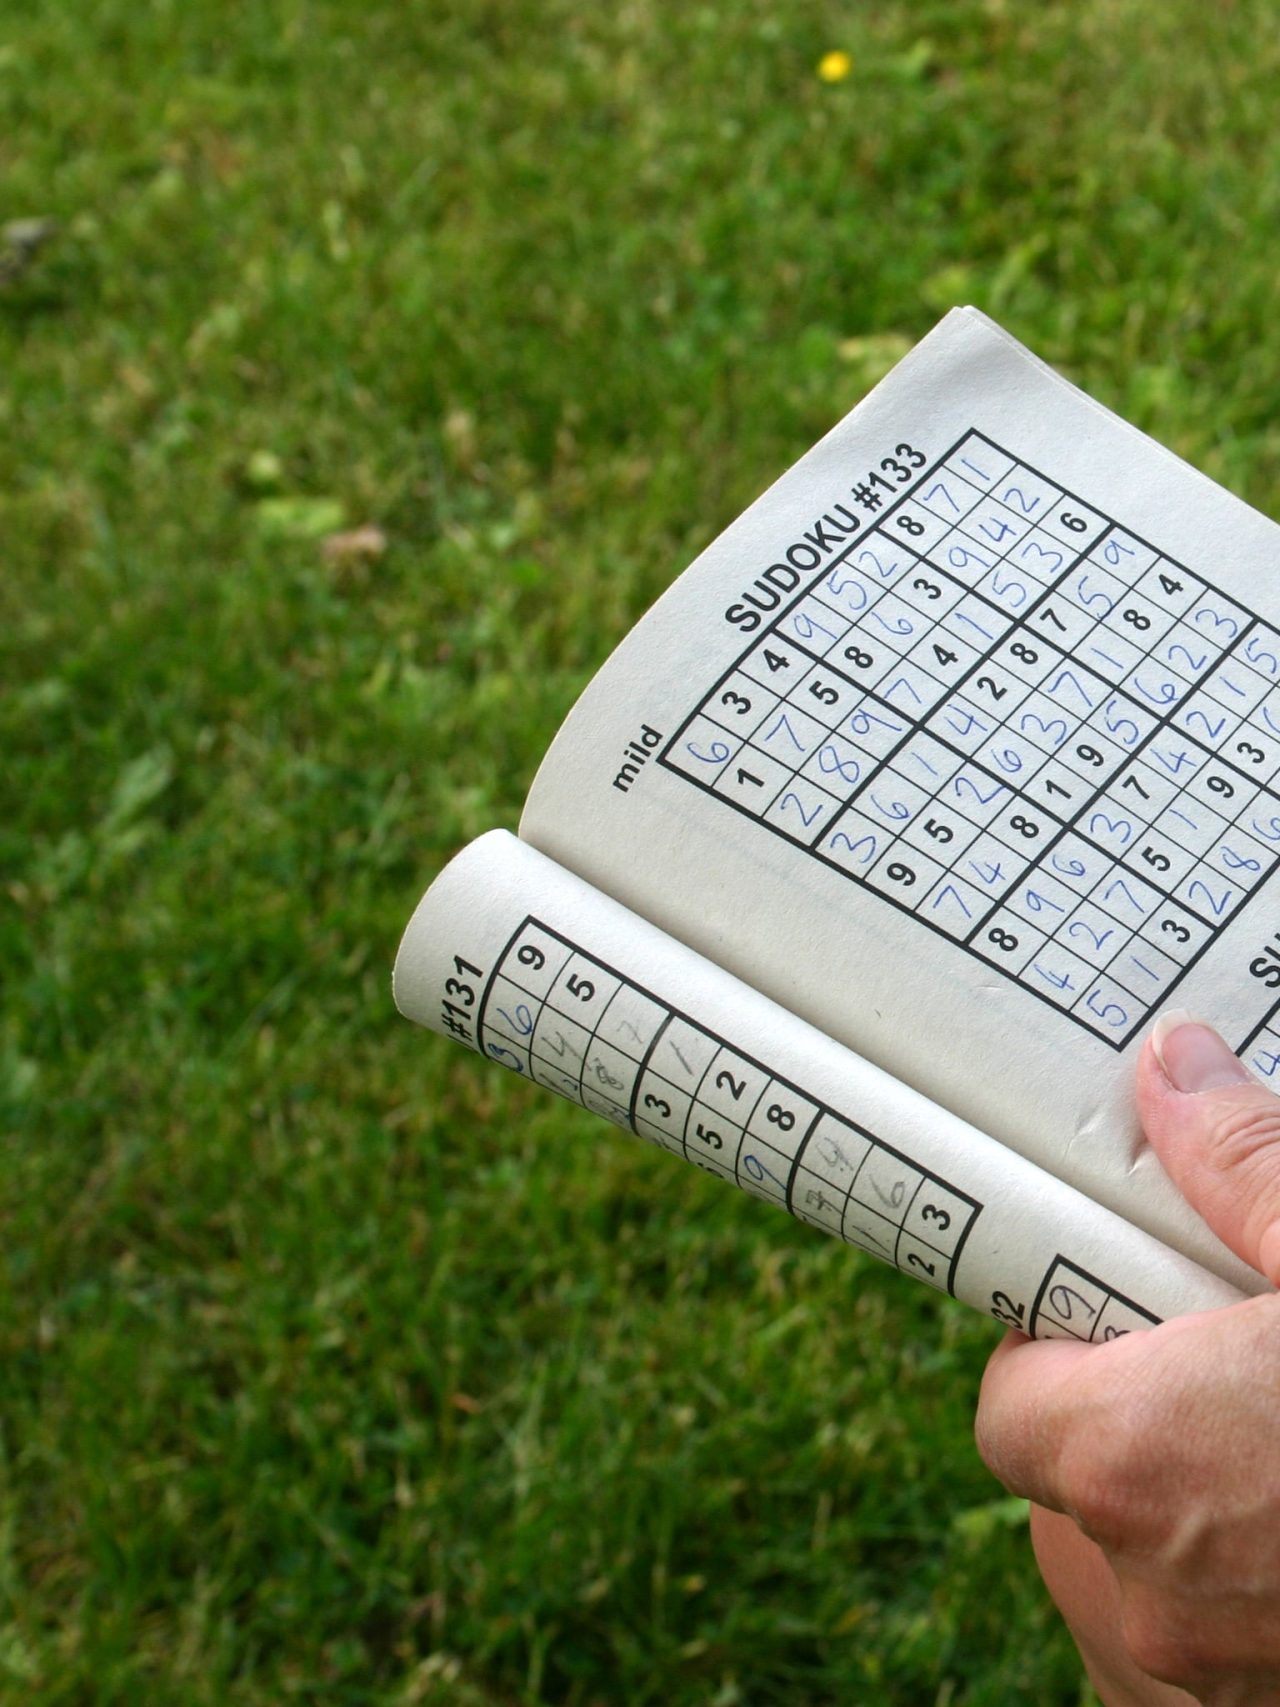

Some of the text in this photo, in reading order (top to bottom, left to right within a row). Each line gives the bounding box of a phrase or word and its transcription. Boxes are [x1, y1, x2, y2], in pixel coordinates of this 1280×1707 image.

[923, 459, 989, 511] 7 1
[724, 443, 928, 633] SUDOKU #133
[897, 516, 924, 536] 8
[948, 487, 1039, 567] 9 4 2
[1061, 513, 1087, 532] 6
[793, 551, 896, 640] 9 5 2
[914, 579, 941, 599] 3
[955, 543, 1062, 640] 1 5 3
[1078, 540, 1135, 621] 5 9
[1123, 575, 1183, 630] 8 4
[873, 613, 912, 635] 6
[809, 646, 873, 705] 5 8
[933, 644, 958, 666] 4
[977, 608, 1066, 700] 2 8 7
[1107, 610, 1240, 745] 5 6 2 3
[722, 651, 789, 714] 3 4
[1151, 638, 1279, 773] 4 2 1 5
[686, 741, 731, 765] 6
[765, 716, 805, 752] 7
[779, 679, 922, 827] 2 8 9 7
[955, 649, 1122, 805] 2 6 3 7 1
[612, 724, 664, 793] mild
[737, 768, 764, 787] 1
[828, 705, 987, 864] 3 6 1 4
[1207, 743, 1265, 798] 9 3
[1010, 745, 1104, 838] 8 1 9
[1122, 775, 1150, 799] 7
[1171, 811, 1197, 828] 1
[887, 819, 953, 886] 9 5
[1025, 814, 1133, 912] 9 6 3
[1142, 847, 1170, 871] 5
[933, 864, 1003, 918] 7 4
[1189, 881, 1231, 916] 2
[1221, 847, 1262, 873] 8
[517, 944, 546, 970] 9
[989, 928, 1018, 951] 8
[1033, 881, 1143, 991] 4 2 7
[1162, 920, 1190, 942] 3
[441, 954, 484, 1041] #131
[566, 974, 595, 1001] 5
[1086, 957, 1158, 1030] 5 1
[496, 1005, 533, 1036] 6
[644, 1094, 671, 1118] 3
[696, 1124, 724, 1150] 5
[716, 1071, 747, 1100] 2
[767, 1104, 796, 1131] 8
[743, 1154, 788, 1190] 9
[870, 1174, 905, 1209] 6
[907, 1204, 951, 1276] 2 3
[991, 1290, 1026, 1330] 32
[1049, 1285, 1096, 1320] 9
